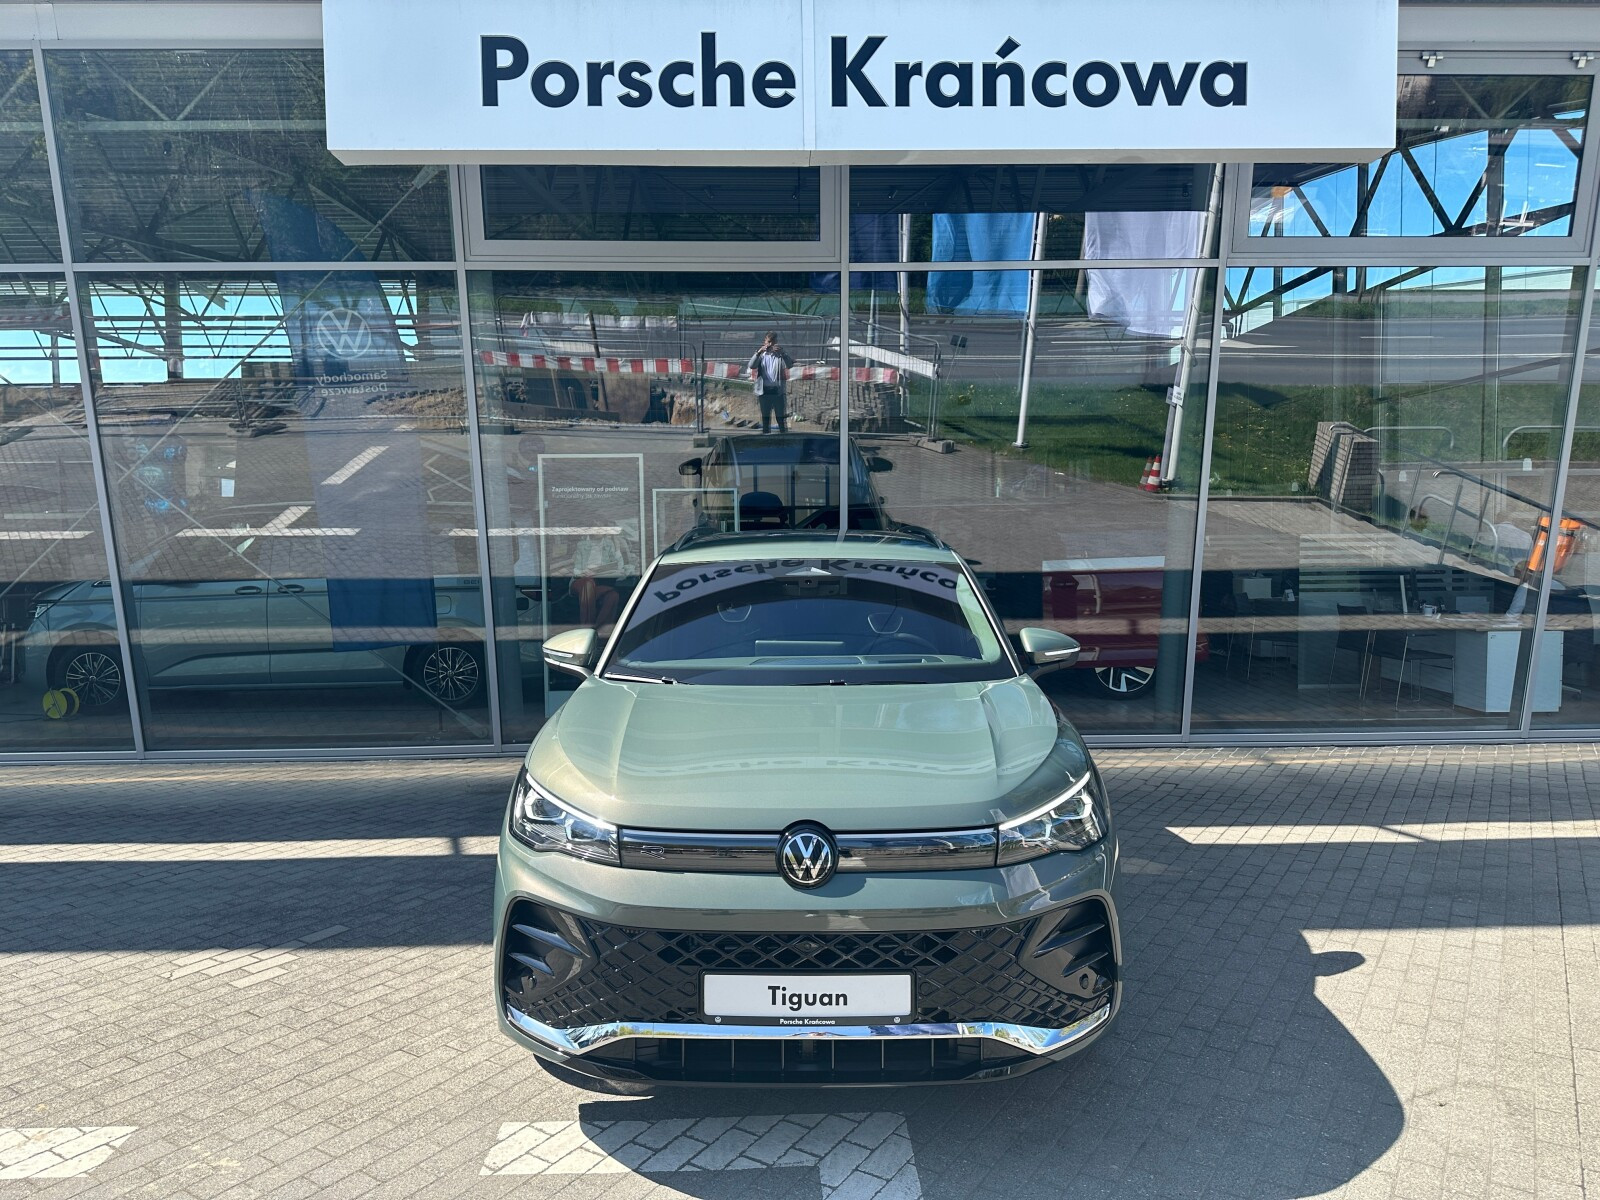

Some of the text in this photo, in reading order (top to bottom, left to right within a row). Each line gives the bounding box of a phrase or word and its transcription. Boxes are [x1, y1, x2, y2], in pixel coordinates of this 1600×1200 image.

[480, 32, 1249, 108] Porsche Krańcowa
[767, 985, 848, 1011] Tiguan
